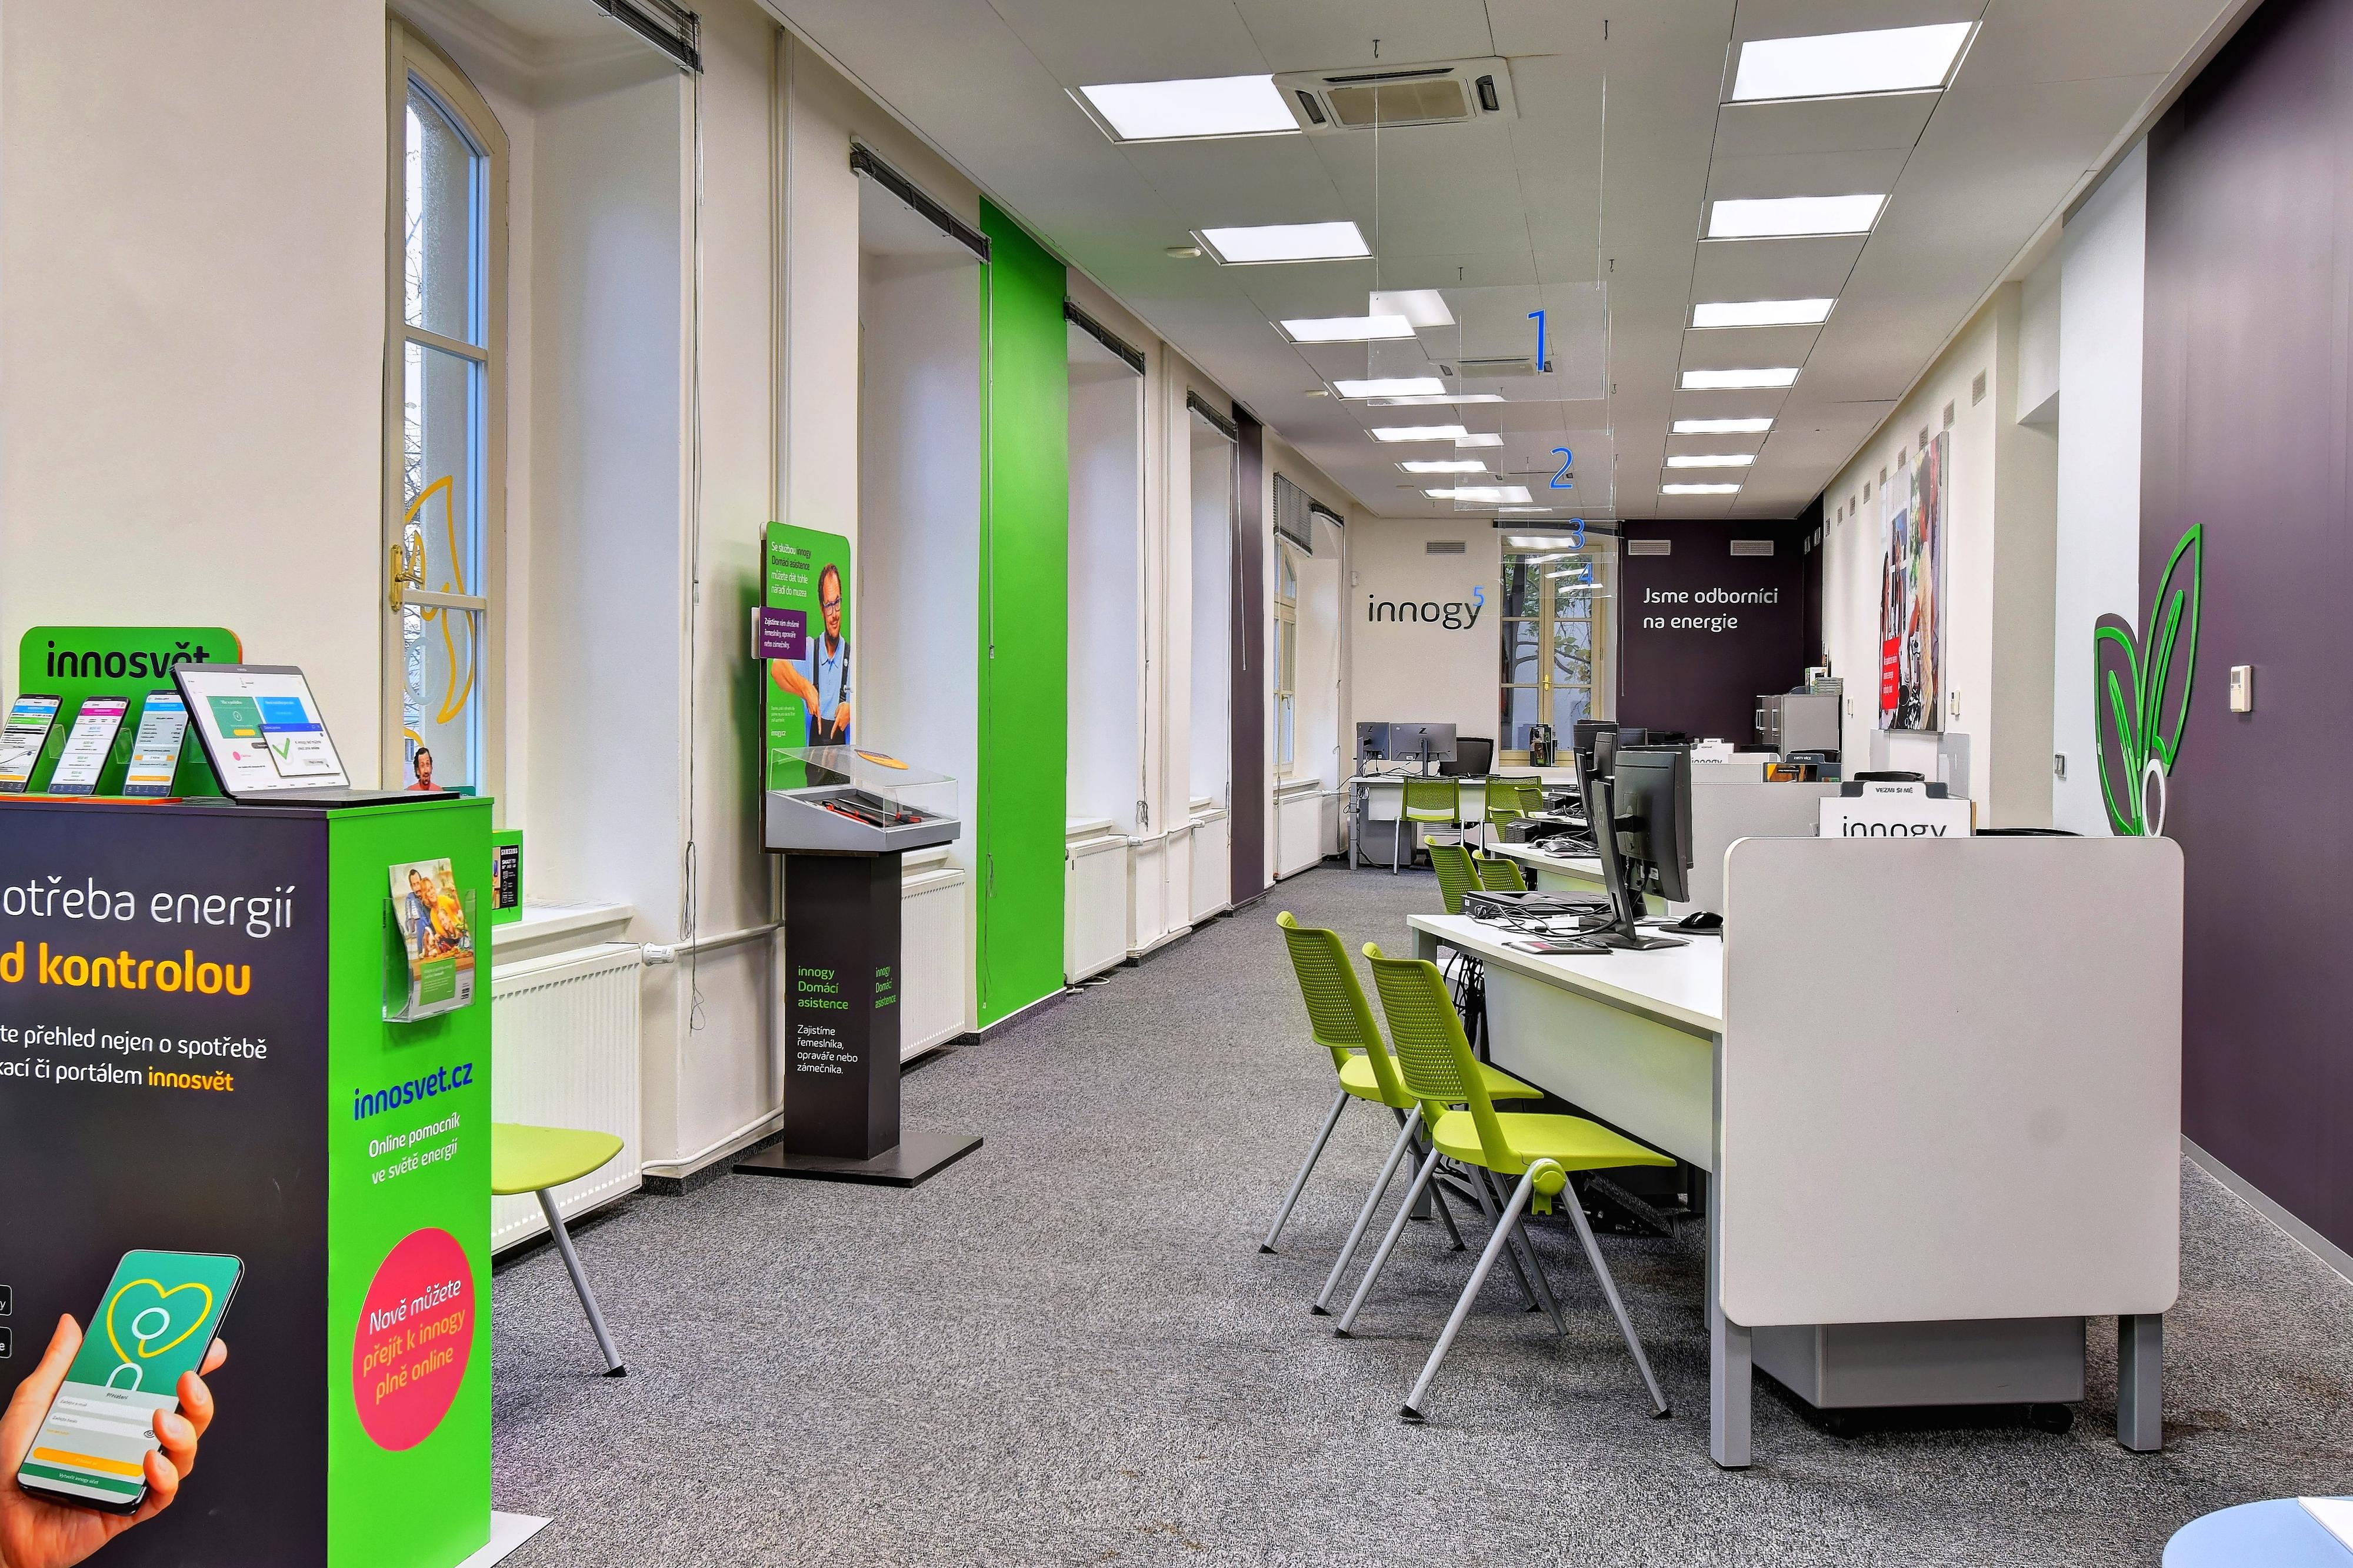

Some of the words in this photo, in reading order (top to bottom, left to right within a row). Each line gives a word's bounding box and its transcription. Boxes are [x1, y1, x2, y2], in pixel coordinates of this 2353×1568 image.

[1527, 309, 1545, 372] 1
[1549, 447, 1573, 489] 2
[1568, 518, 1585, 549] 3
[772, 542, 778, 551] Se
[796, 546, 811, 559] innogy
[772, 556, 789, 566] Domácí
[789, 559, 810, 571] asistence
[1578, 562, 1594, 586] 4
[771, 569, 788, 581] můžete
[786, 586, 792, 595] do
[792, 589, 807, 597] muzea
[1472, 586, 1485, 607] 5
[1644, 588, 1689, 604] Jsme
[1695, 588, 1778, 604] odborníci
[1369, 594, 1482, 630] innogy
[1644, 617, 1665, 629] na
[1671, 613, 1738, 633] energie
[47, 640, 210, 678] innosvět
[3, 875, 135, 921] otřeba
[151, 885, 295, 938] energií
[0, 941, 25, 983] d
[39, 942, 251, 995] kontrolou
[798, 966, 835, 979] innogy
[875, 966, 891, 978] innogy
[798, 981, 839, 993] Domácí
[875, 978, 892, 993] Domácí
[798, 997, 848, 1010] asistence
[875, 995, 896, 1009] asistence
[797, 1025, 835, 1036] Zajistíme
[0, 1025, 18, 1043] te
[24, 1025, 95, 1047] přehled
[101, 1031, 153, 1055] nejen
[159, 1038, 172, 1053] o
[178, 1037, 267, 1059] spotřebě
[797, 1037, 844, 1050] řemeslníka,
[797, 1052, 835, 1061] opraváře
[836, 1053, 858, 1062] nebo
[35, 1058, 49, 1079] či
[56, 1063, 142, 1085] portálem
[149, 1066, 234, 1091] innosvět
[797, 1063, 844, 1074] zámečníka.
[354, 1063, 473, 1120] innosvet.cz
[369, 1135, 406, 1157] Online
[409, 1112, 461, 1147] pomocník
[372, 1168, 386, 1184] ve
[388, 1152, 418, 1179] světě
[421, 1137, 458, 1167] energií
[369, 1299, 406, 1335] Nově
[410, 1279, 462, 1316] můžete
[363, 1336, 403, 1377] přejít
[406, 1329, 415, 1349] k
[419, 1309, 465, 1343] innogy
[376, 1363, 408, 1405] plně
[412, 1347, 454, 1380] online
